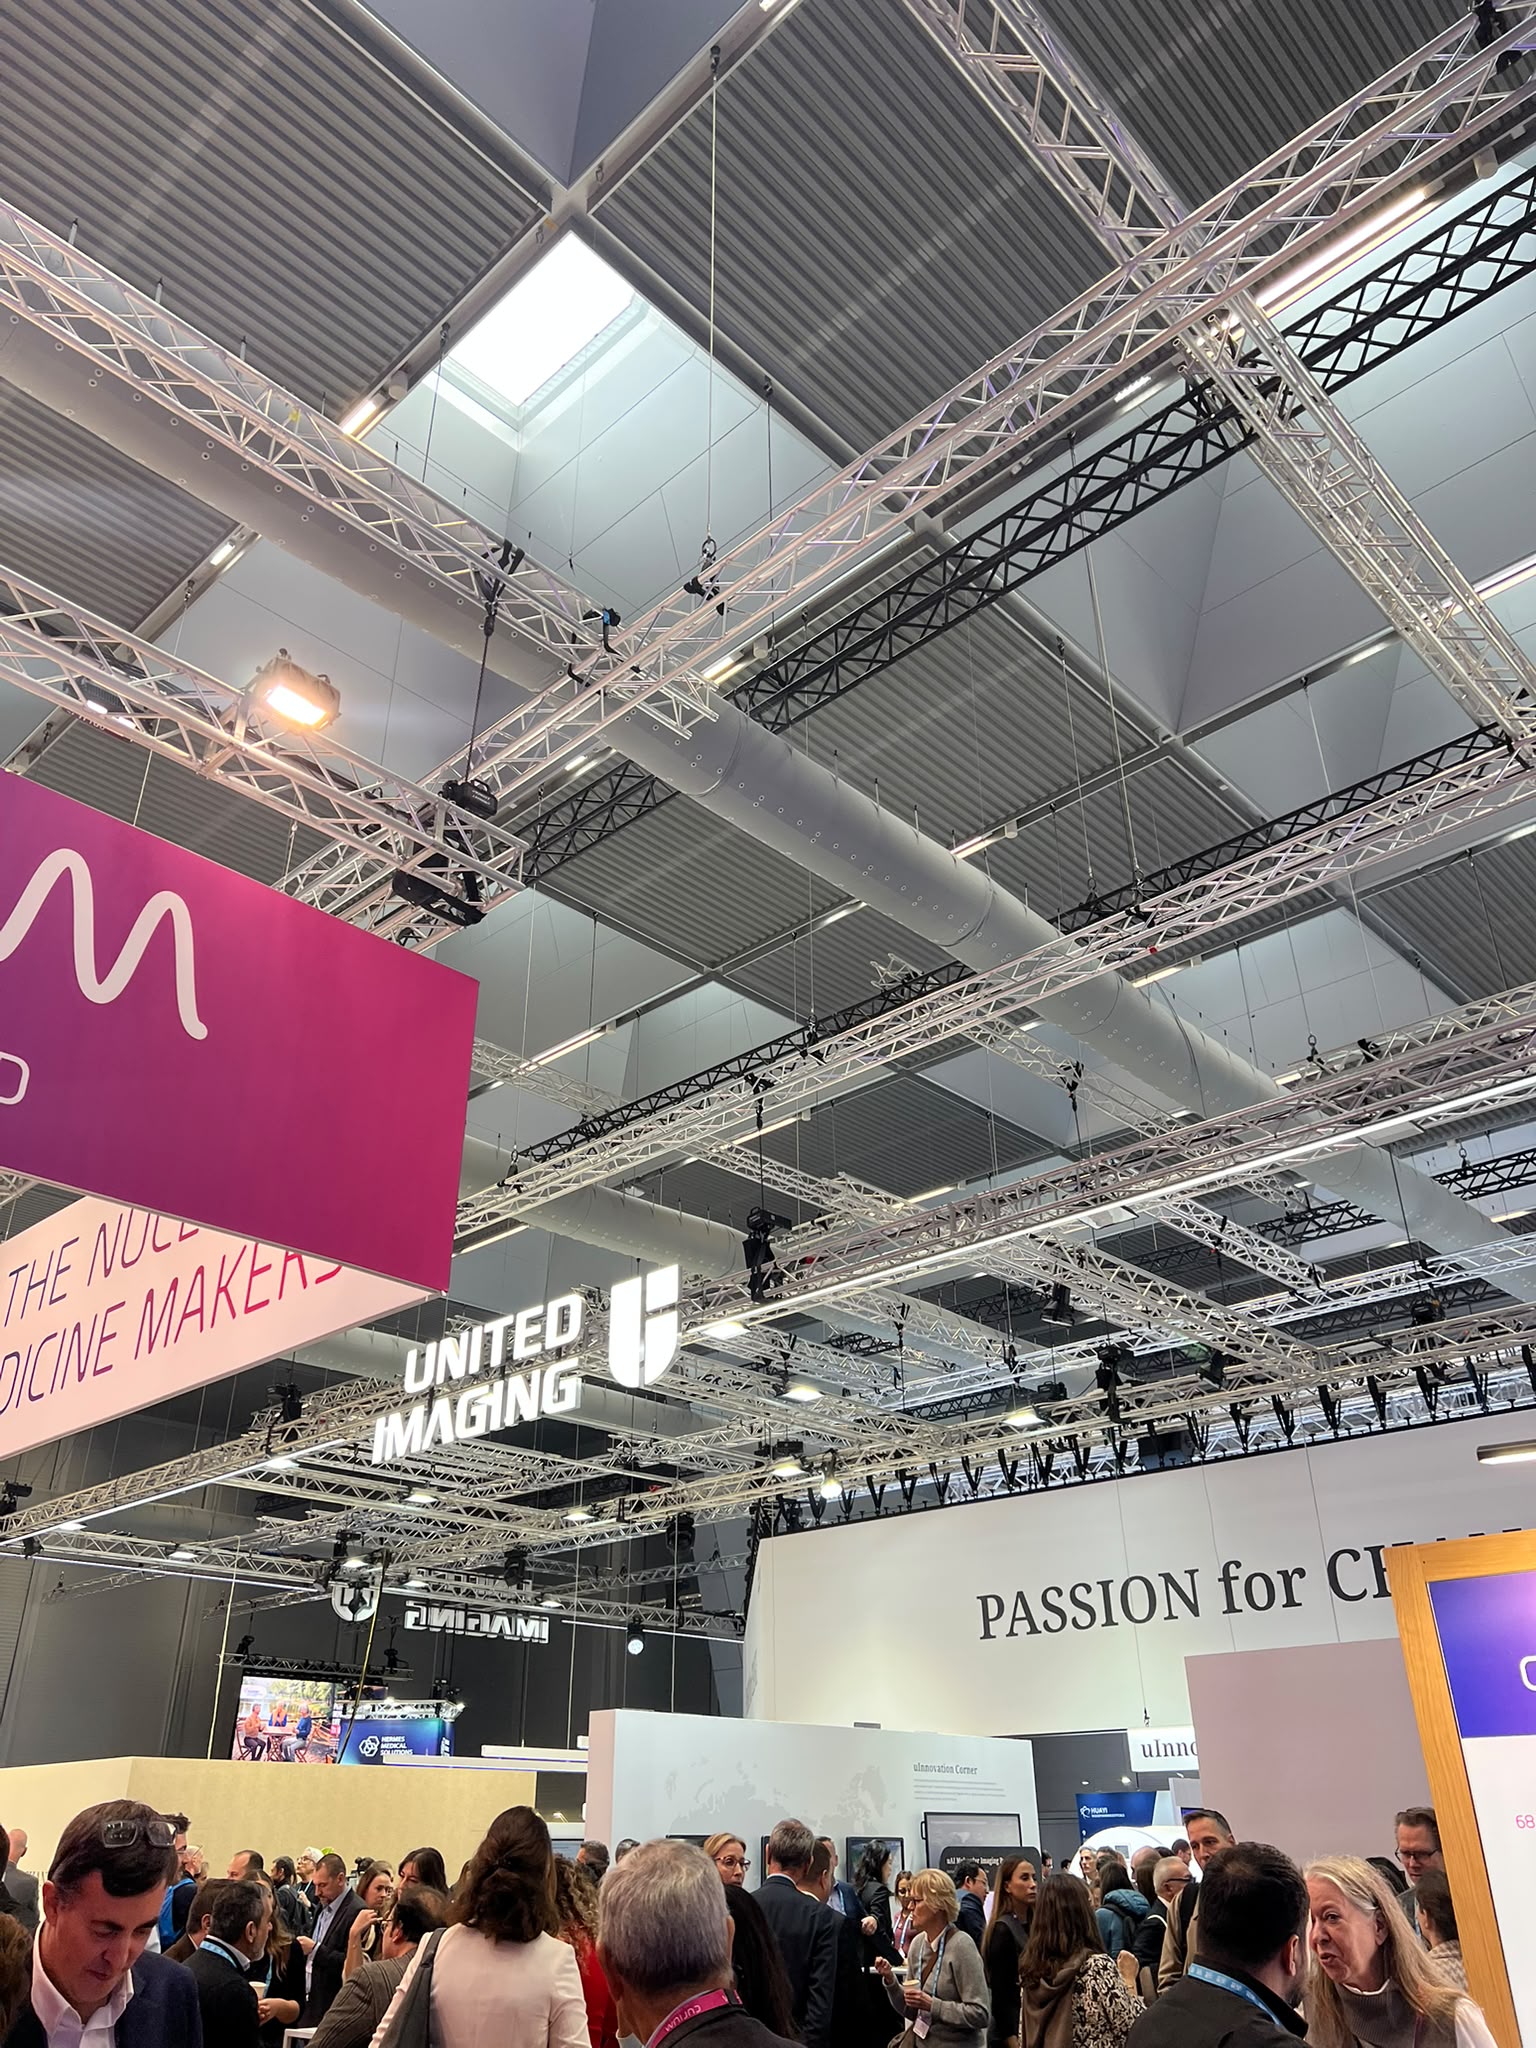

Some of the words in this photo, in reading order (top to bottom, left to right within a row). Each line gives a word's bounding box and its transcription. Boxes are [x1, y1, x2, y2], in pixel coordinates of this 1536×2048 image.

[4, 1236, 80, 1328] THE
[134, 1242, 343, 1360] MAKER
[404, 1293, 584, 1394] UNITED
[372, 1357, 582, 1465] IMAGING
[976, 1567, 1200, 1640] PASSION
[1217, 1560, 1307, 1615] for
[955, 1764, 978, 1775] Corner
